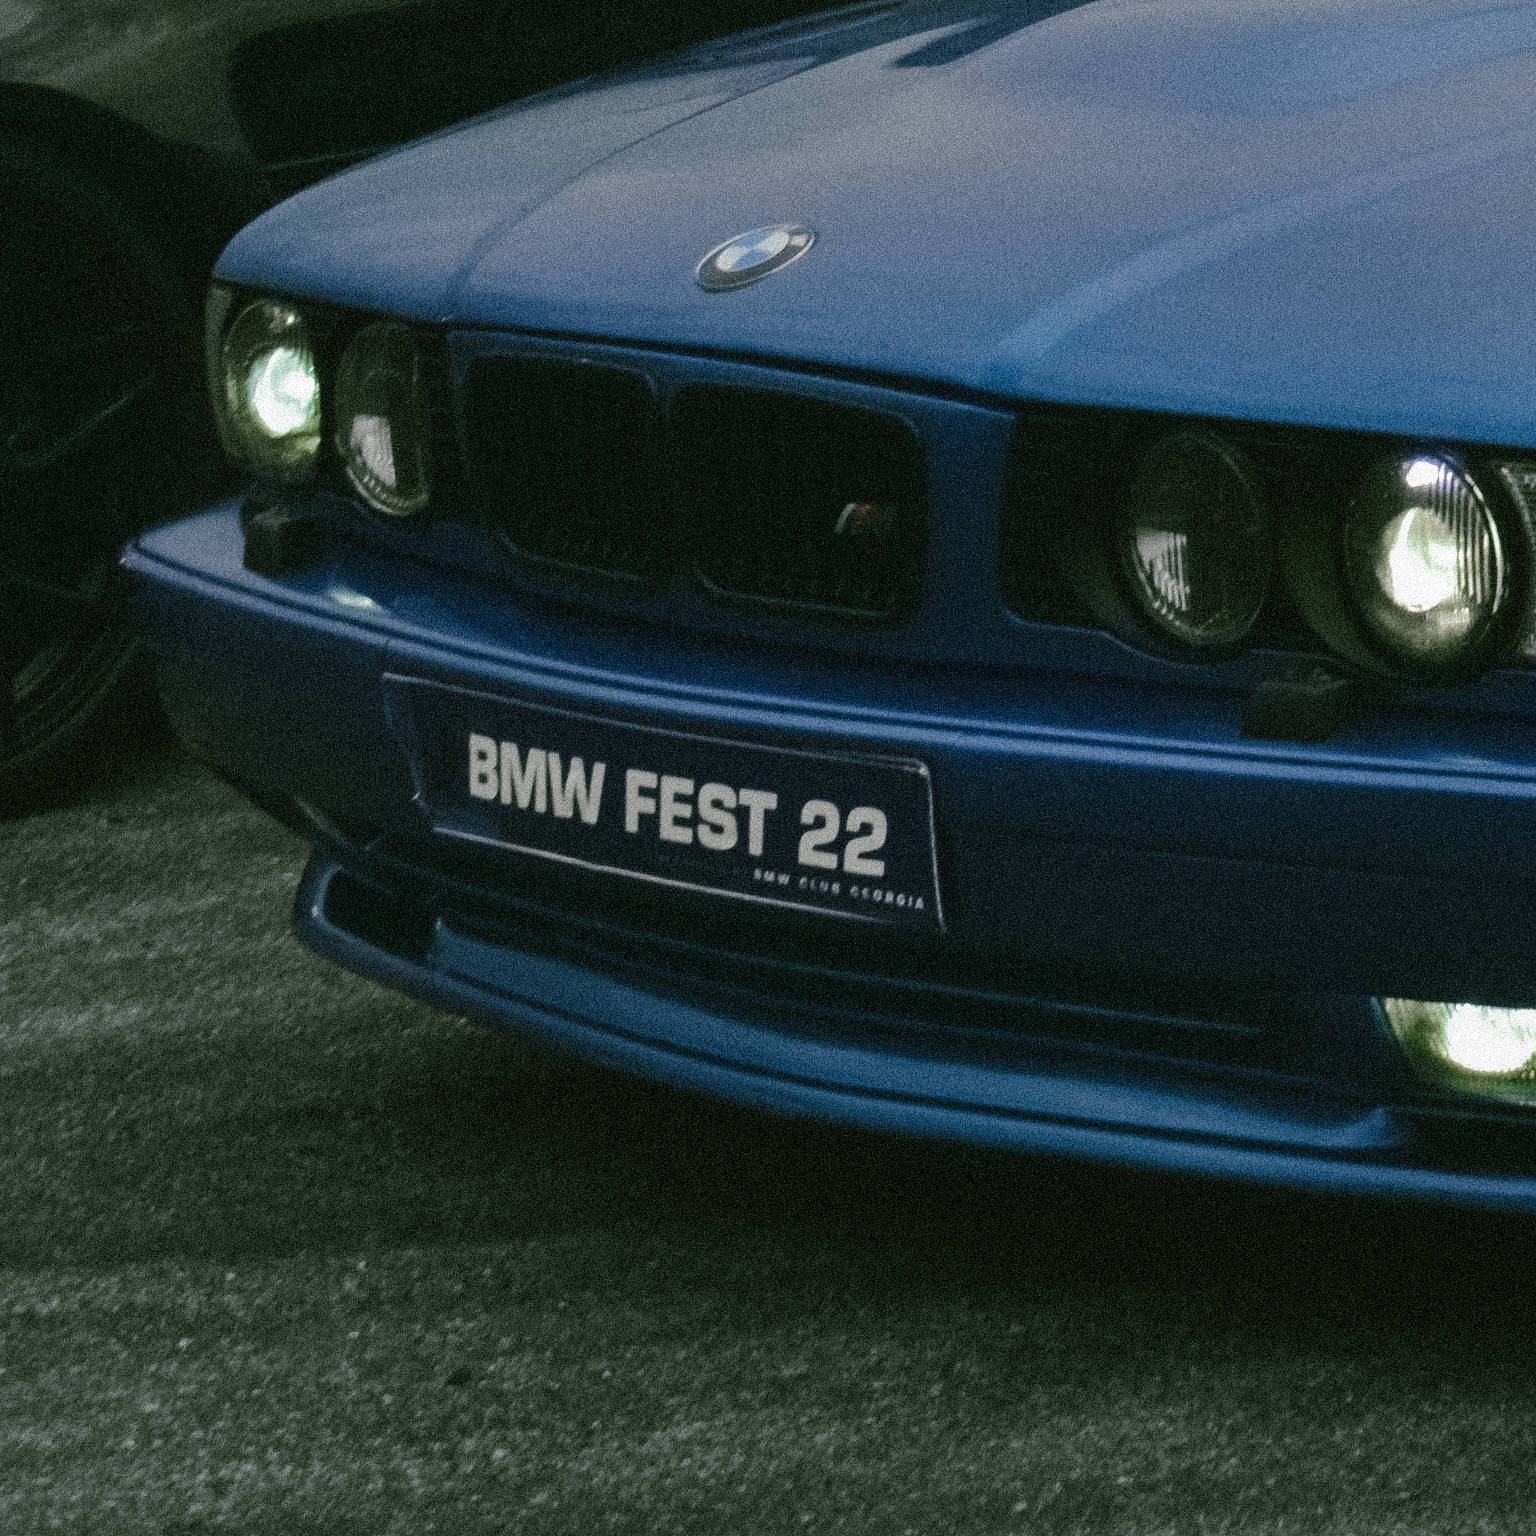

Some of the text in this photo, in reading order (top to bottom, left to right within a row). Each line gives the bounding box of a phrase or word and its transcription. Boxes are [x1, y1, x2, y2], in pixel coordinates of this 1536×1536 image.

[468, 733, 888, 878] BMW FEST 22
[753, 867, 925, 911] BMW CLUB GEORGIA
